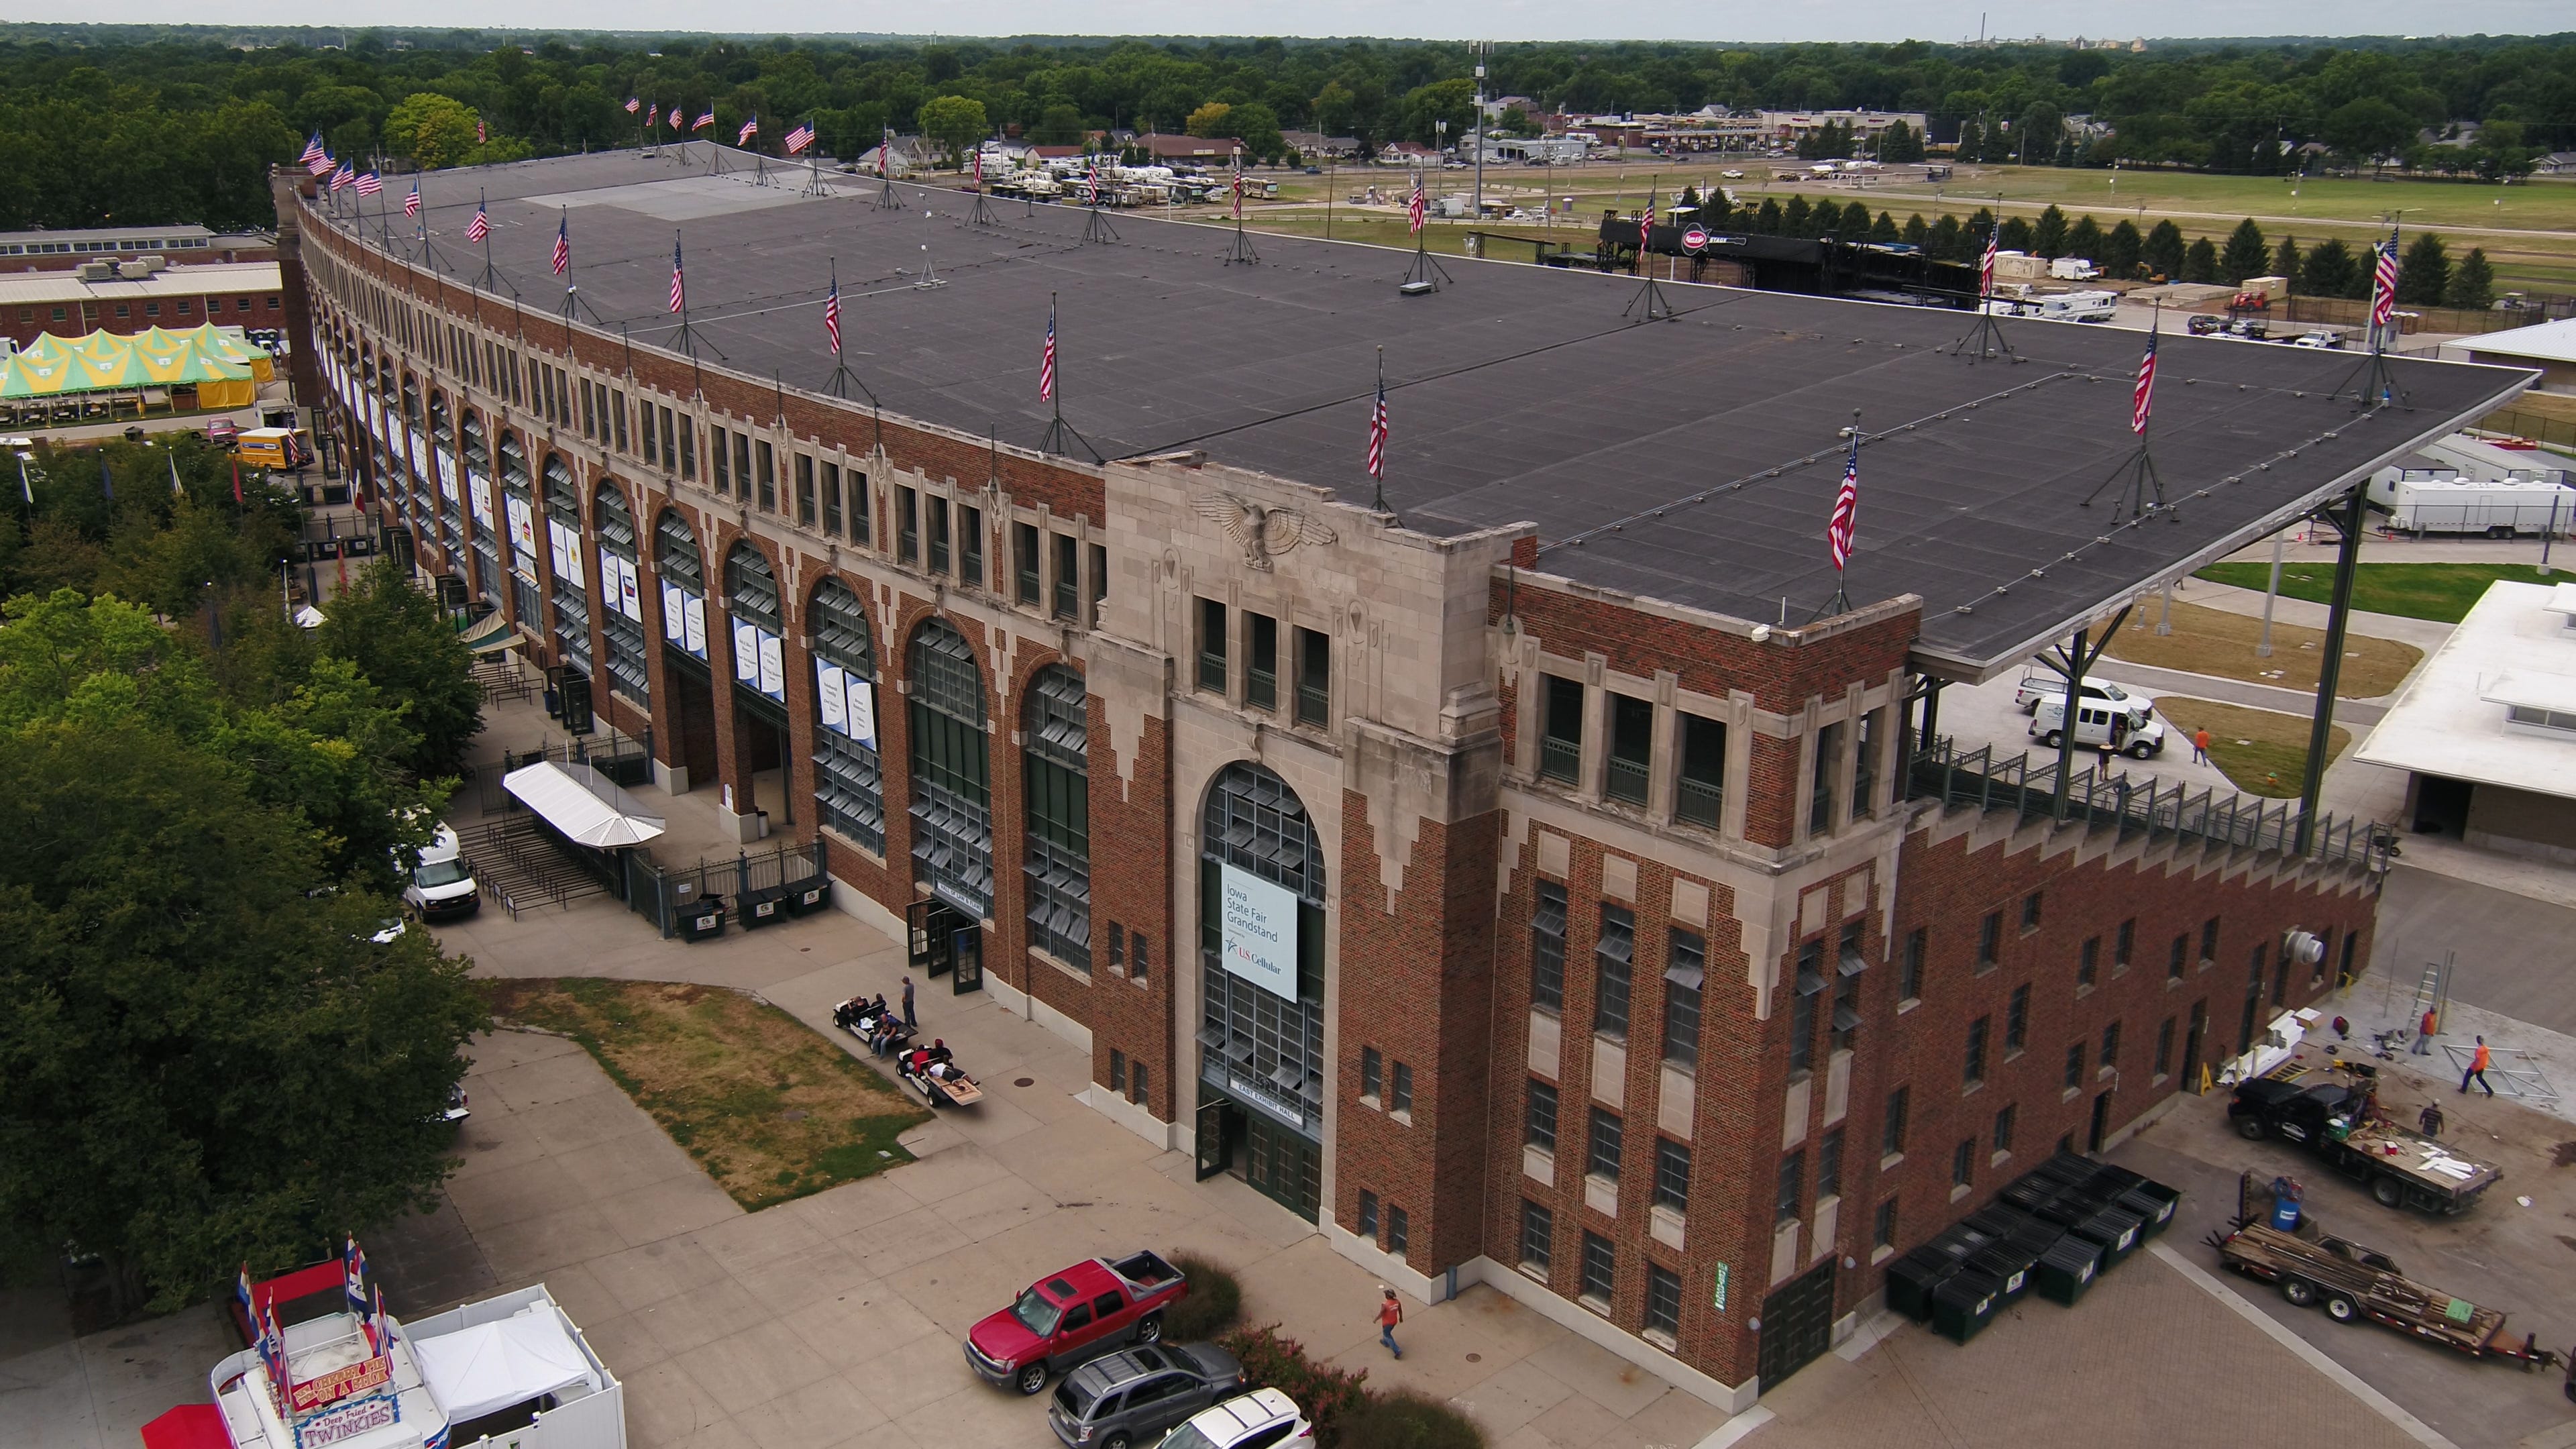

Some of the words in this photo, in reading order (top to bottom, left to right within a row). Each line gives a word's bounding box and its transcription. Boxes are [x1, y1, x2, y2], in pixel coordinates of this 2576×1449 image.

[1227, 883, 1247, 902] Iowa
[1227, 897, 1249, 916] State
[1252, 908, 1267, 924] Fair
[1227, 911, 1278, 943] Grandstand
[1251, 953, 1281, 975] Cellular
[1238, 1083, 1253, 1097] EAST
[1254, 1093, 1278, 1110] EXHIBIT
[1279, 1106, 1295, 1120] HALL
[313, 1364, 361, 1391] CHERRY
[364, 1356, 386, 1375] PIE
[317, 1385, 335, 1403] ON
[339, 1382, 350, 1396] A
[352, 1368, 389, 1391] STICK
[305, 1405, 390, 1447] TWINKIES
[323, 1417, 343, 1427] Deep
[345, 1406, 367, 1419] Fried
